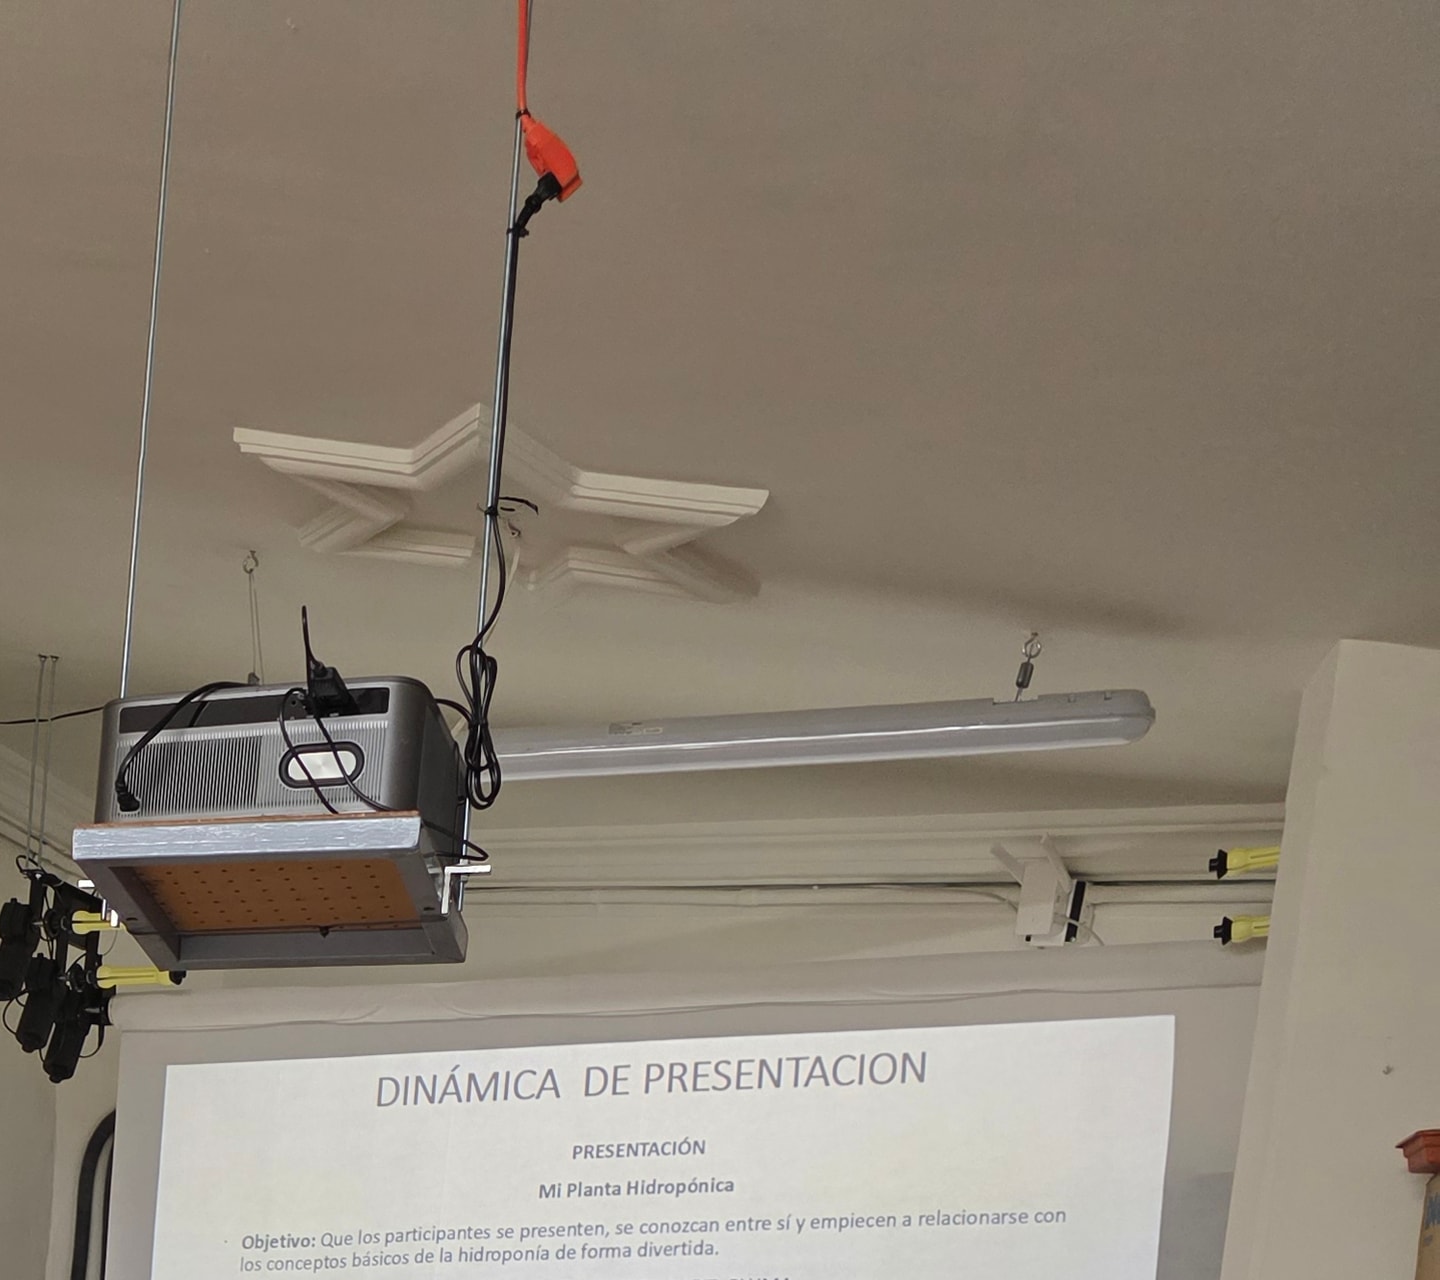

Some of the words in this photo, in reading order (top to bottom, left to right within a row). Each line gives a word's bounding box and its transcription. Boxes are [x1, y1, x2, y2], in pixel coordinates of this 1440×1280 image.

[376, 1064, 561, 1108] DINÁMICA
[584, 1064, 632, 1098] DE
[644, 1051, 927, 1095] PRESENTACION
[571, 1135, 707, 1161] PRESENTACIÓN
[537, 1181, 563, 1200] Mi
[565, 1179, 623, 1199] Planta
[625, 1175, 735, 1199] Hidropónica
[240, 1232, 318, 1255] Objetivo:
[319, 1230, 355, 1250] Que
[356, 1228, 382, 1247] los
[383, 1224, 492, 1249] participantes
[494, 1227, 516, 1242] se
[518, 1221, 611, 1244] presenten,
[613, 1222, 635, 1237] se
[638, 1218, 721, 1236] conozcan
[723, 1215, 773, 1233] entre
[775, 1212, 793, 1232] sí
[794, 1217, 807, 1236] y
[809, 1211, 898, 1234] empiecen
[901, 1214, 913, 1228] a
[917, 1207, 1030, 1228] relacionarse
[1033, 1209, 1067, 1226] con
[239, 1255, 264, 1274] los
[265, 1253, 349, 1275] conceptos
[350, 1248, 411, 1268] básicos
[413, 1247, 436, 1265] de
[438, 1246, 454, 1265] la
[457, 1243, 551, 1267] hidroponía
[554, 1242, 578, 1262] de
[579, 1241, 633, 1261] forma
[635, 1237, 721, 1259] divertida.
